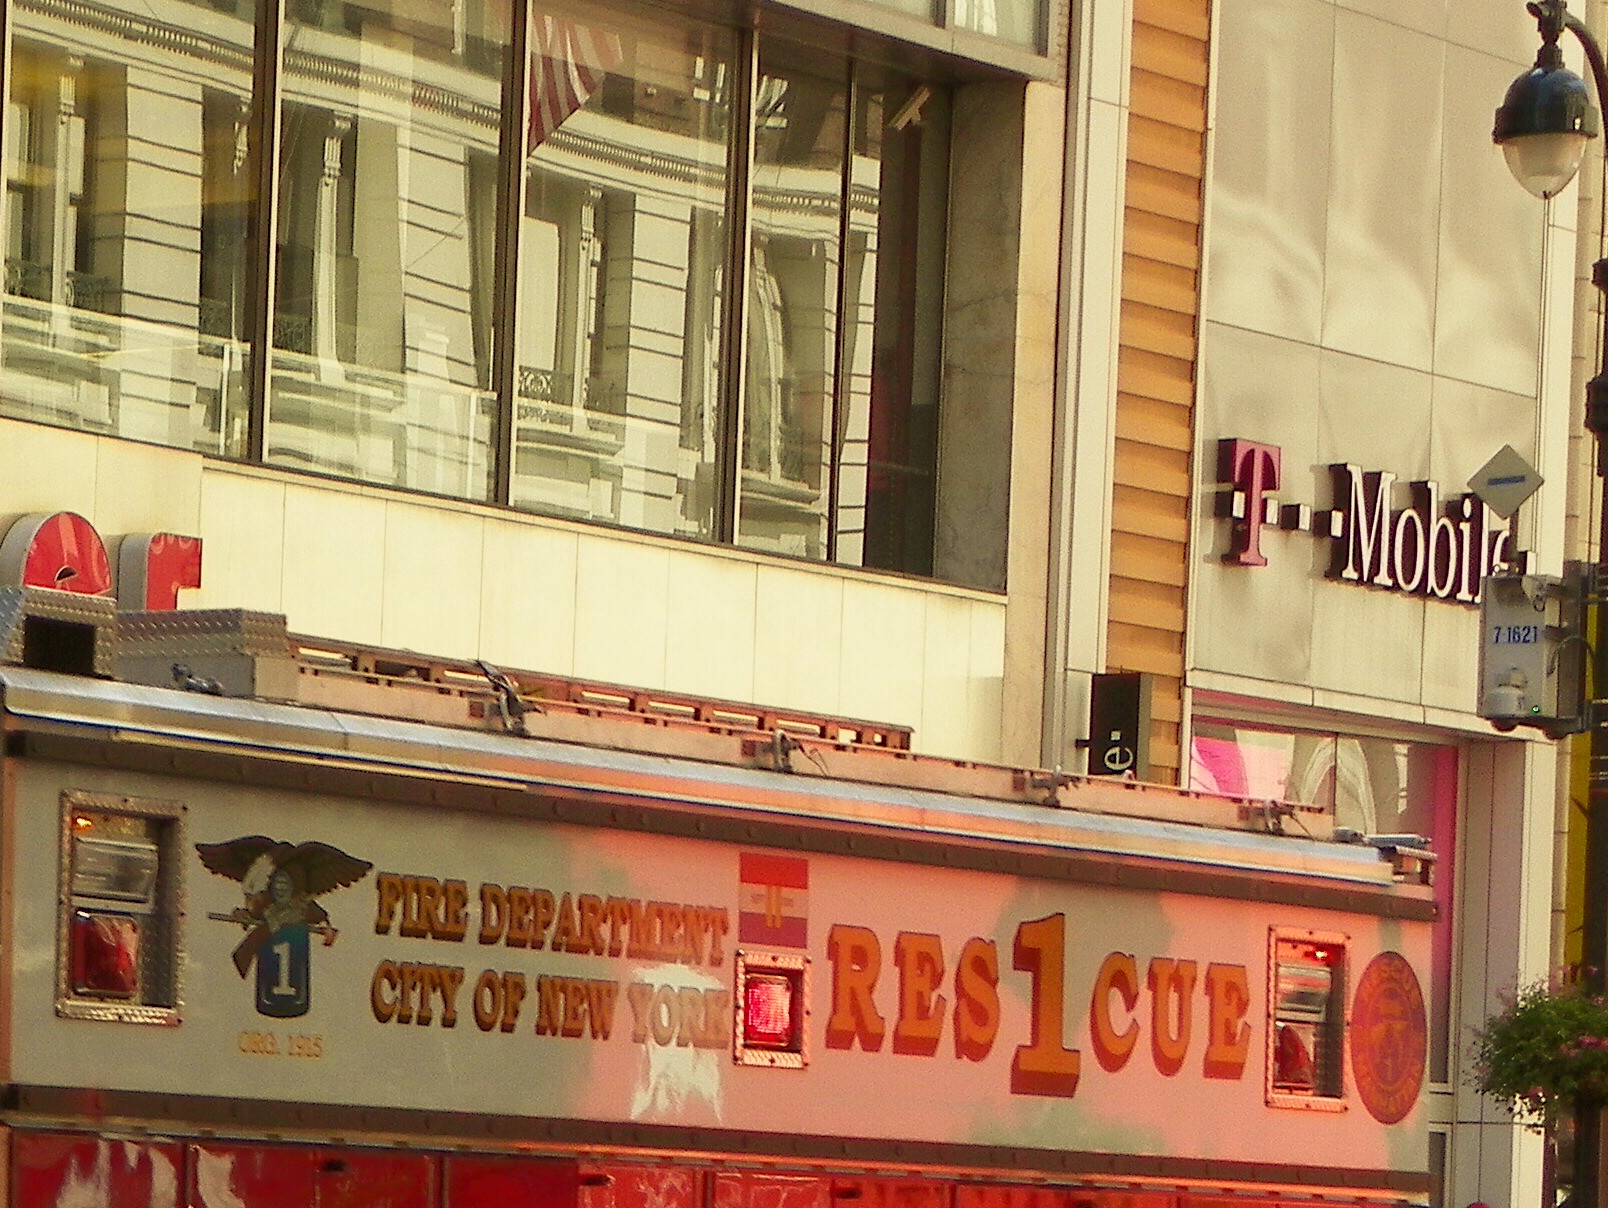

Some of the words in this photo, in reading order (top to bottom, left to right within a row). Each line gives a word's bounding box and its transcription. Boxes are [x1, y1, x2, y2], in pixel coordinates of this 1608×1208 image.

[375, 873, 469, 942] FIRE
[479, 882, 729, 966] DEPARTMENT
[272, 942, 297, 996] 1
[371, 959, 465, 1029] CITY
[473, 970, 528, 1033] OF
[535, 974, 619, 1041] NEW
[628, 984, 730, 1050] YORK
